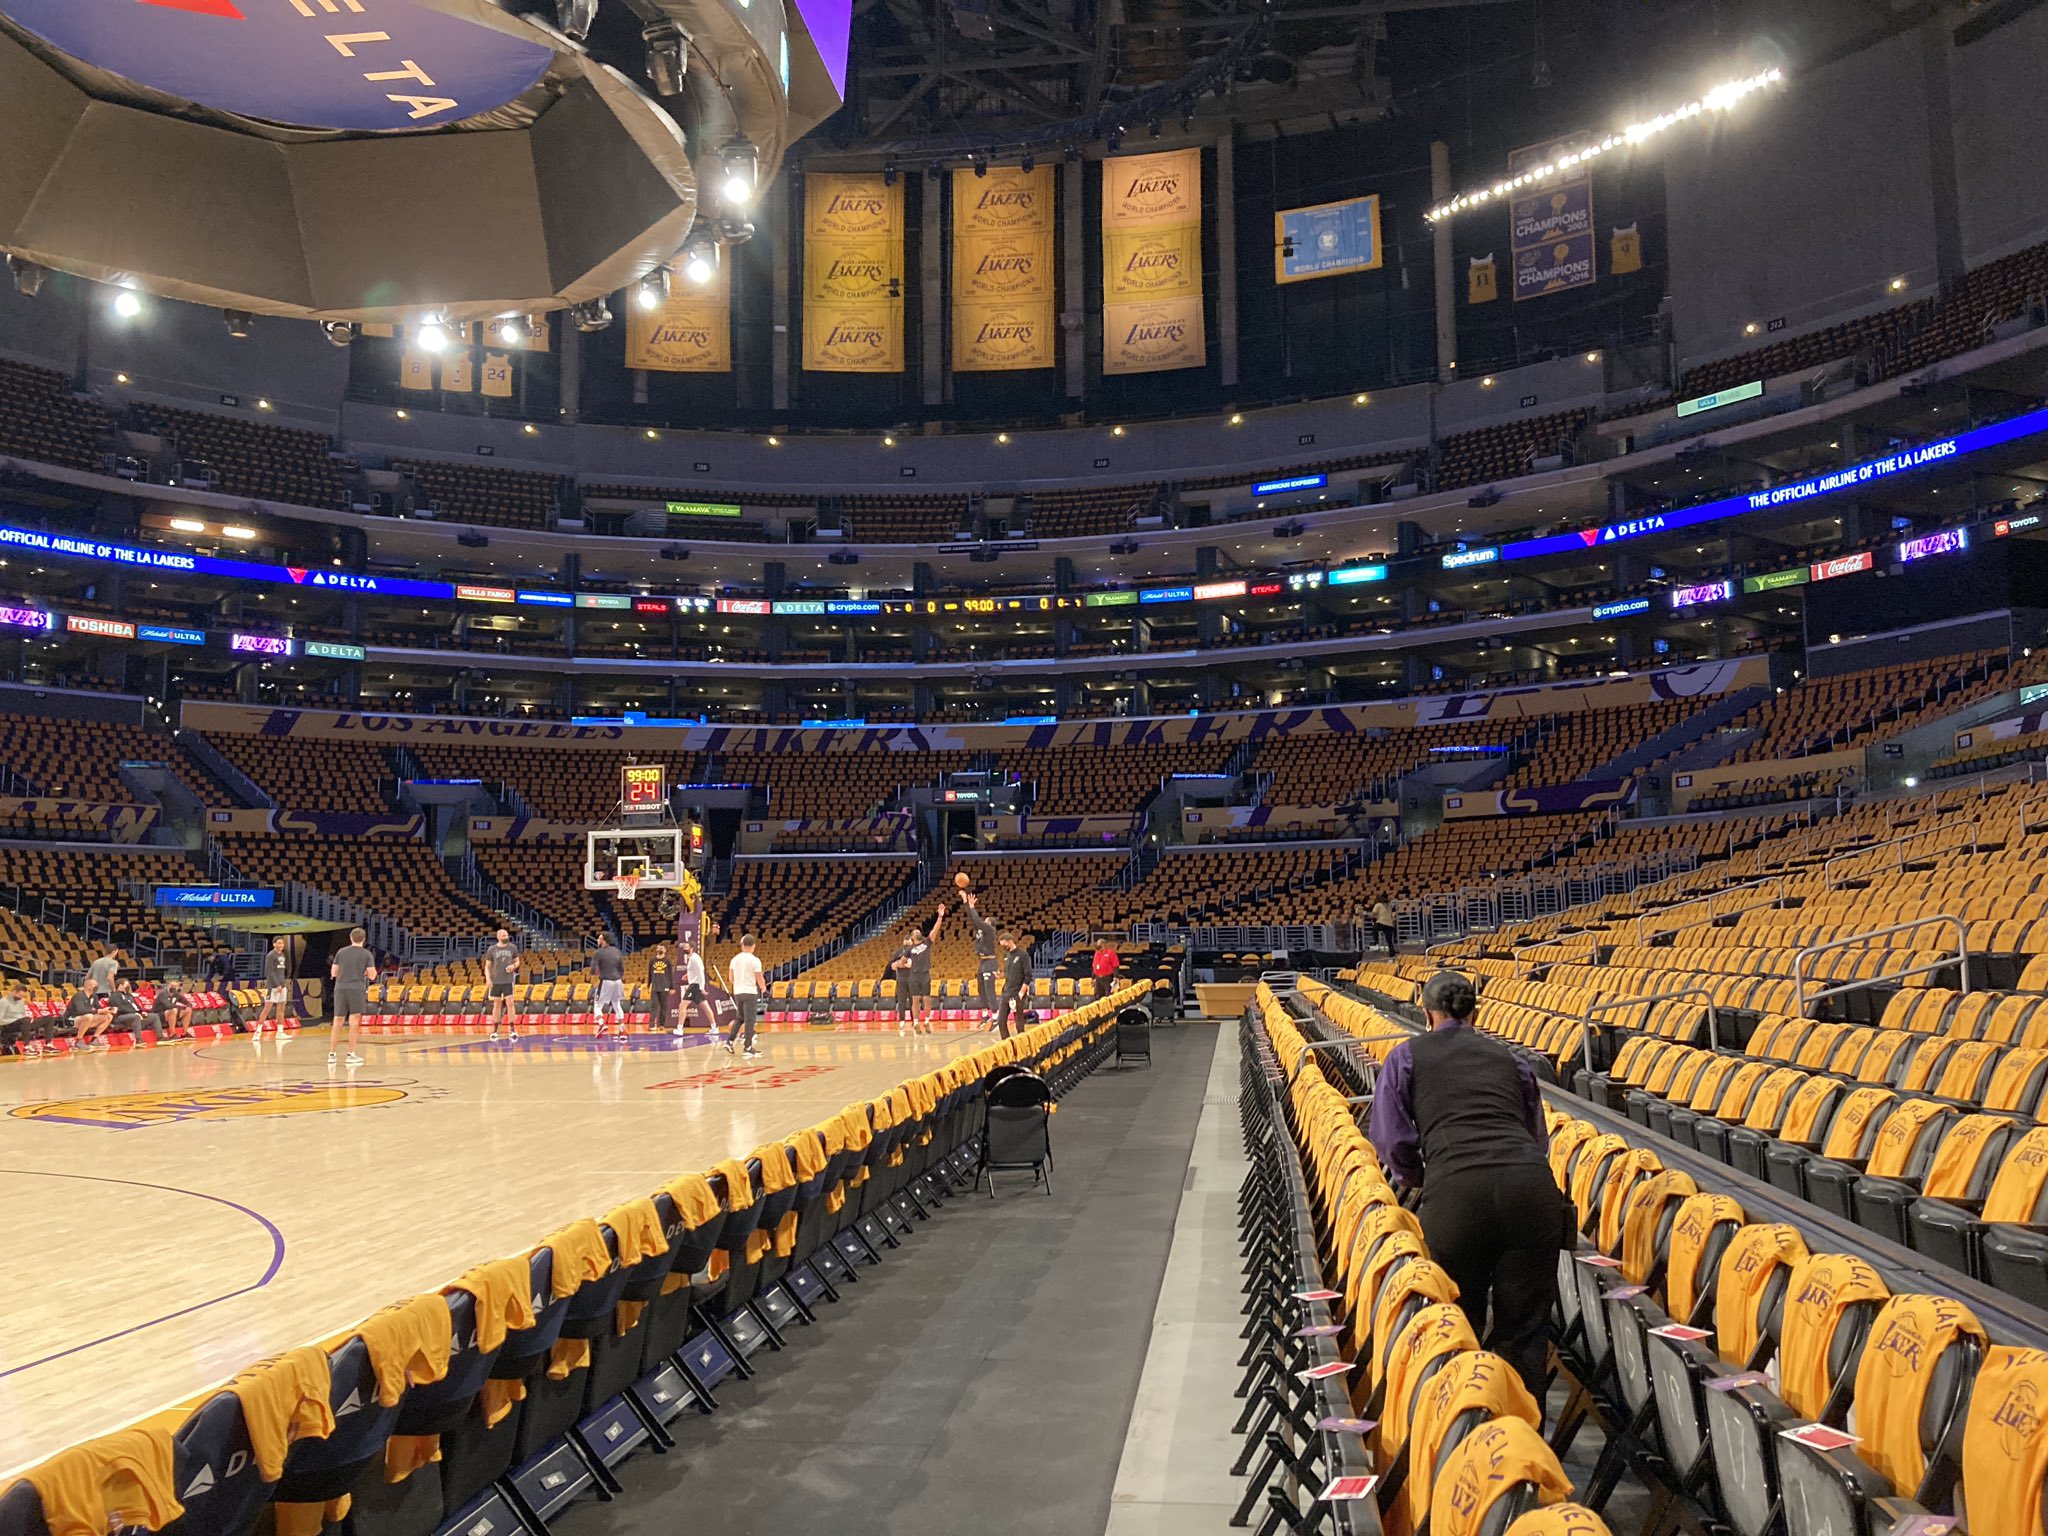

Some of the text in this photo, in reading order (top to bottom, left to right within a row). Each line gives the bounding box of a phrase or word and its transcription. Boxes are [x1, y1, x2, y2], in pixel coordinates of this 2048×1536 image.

[1126, 178, 1180, 198] LAKERS
[827, 194, 885, 216] LAKERS
[976, 190, 1036, 209] LAKERS
[1516, 209, 1587, 237] CHAMPIONS
[976, 255, 1034, 274] LAKERS
[1125, 252, 1180, 272] LAKERS
[826, 260, 884, 282] LAKERS
[1518, 259, 1590, 286] CHAMPIONS
[649, 325, 711, 348] LAKERS
[825, 326, 884, 348] LAKERS
[976, 323, 1034, 343] LAKERS
[1125, 323, 1186, 345] LAKERS
[487, 368, 507, 382] 24
[1748, 440, 1957, 508] THE OFFICIAL AIRLINE OF THE LA LAKERS
[1258, 477, 1320, 492] AMERICAN EXPRESS
[1618, 517, 1665, 536] DELTA
[2009, 516, 2039, 530] TOYOTA
[0, 530, 195, 569] OFFICIAL AIRLINE OF THE LA LAKERS
[1442, 549, 1495, 569] Spectrum
[329, 574, 377, 590] DELTA
[1251, 585, 1281, 595] STEALS
[461, 588, 512, 599] WELLS FARGO
[1168, 590, 1190, 599] ULTRA
[637, 603, 667, 612] STEALS
[786, 603, 823, 613] DELTA
[836, 604, 880, 613] crypto.com
[964, 599, 995, 613] 99:00
[1602, 600, 1649, 616] crypto.com
[70, 619, 133, 637] TOSHIBA
[173, 633, 202, 642] ULTRA
[322, 645, 362, 658] DELTA
[627, 768, 661, 783] 99:00
[631, 782, 657, 801] 24
[957, 792, 979, 800] TOYOTA
[635, 802, 662, 811] TISSOT
[220, 893, 256, 903] ULTRA
